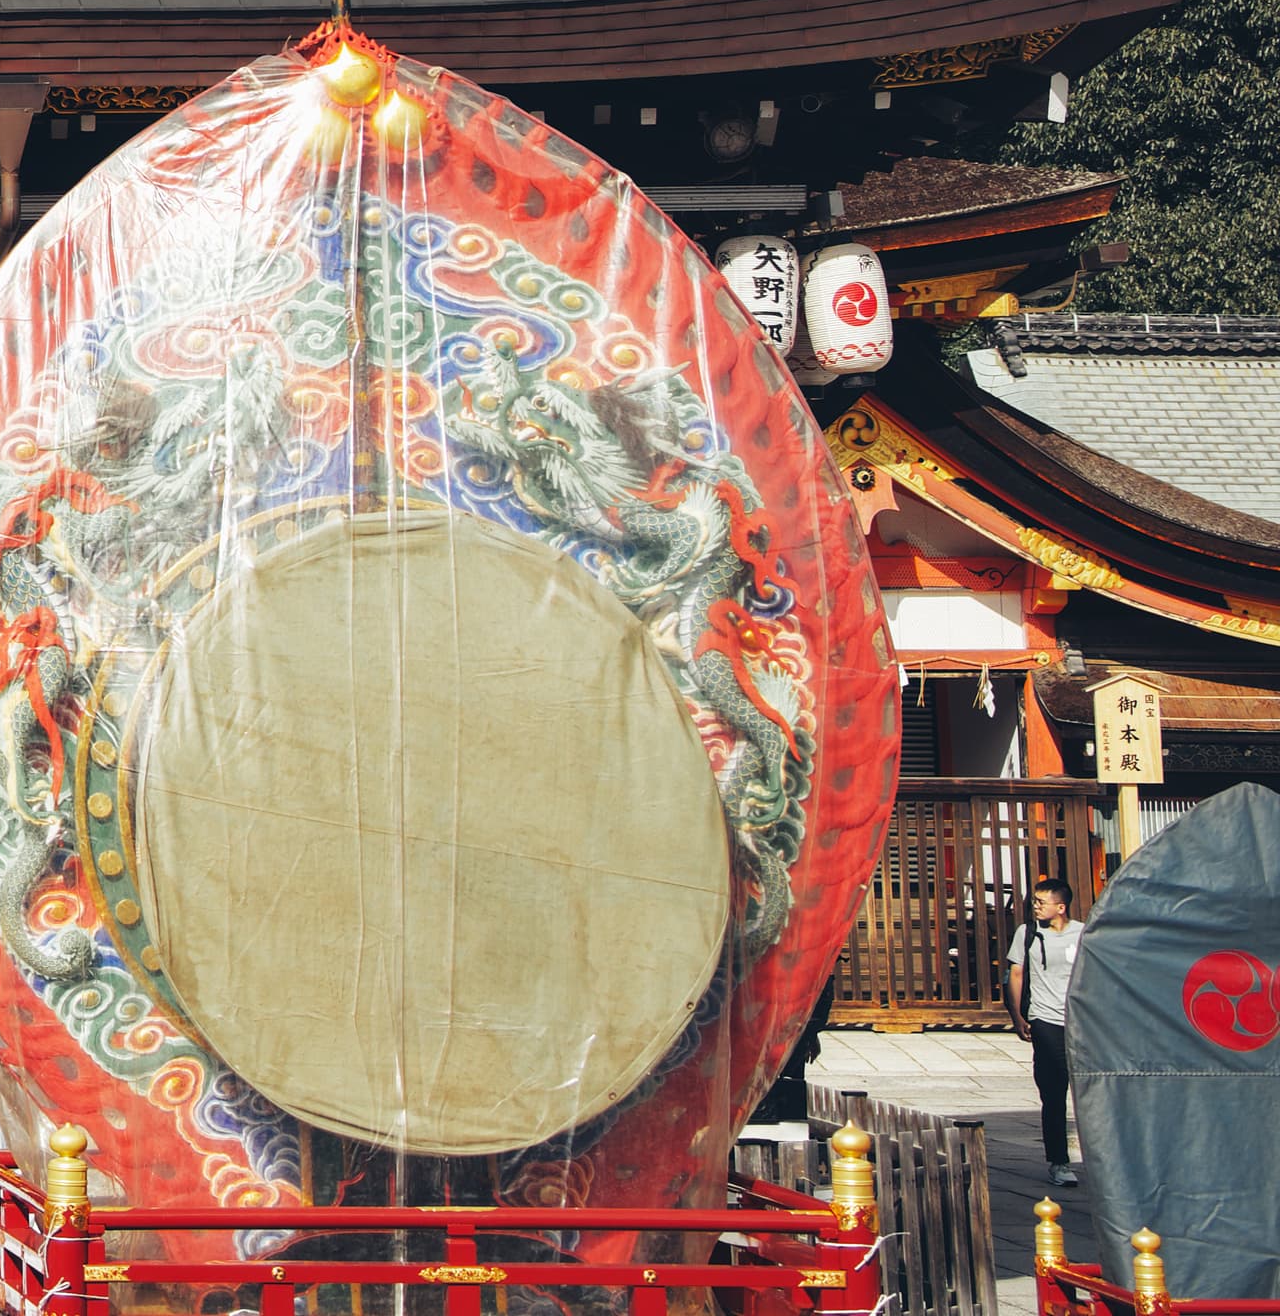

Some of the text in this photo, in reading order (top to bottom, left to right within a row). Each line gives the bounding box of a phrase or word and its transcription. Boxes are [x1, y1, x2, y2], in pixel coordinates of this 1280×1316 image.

[1144, 695, 1155, 718] 国宝
[1117, 696, 1141, 772] 御本殿
